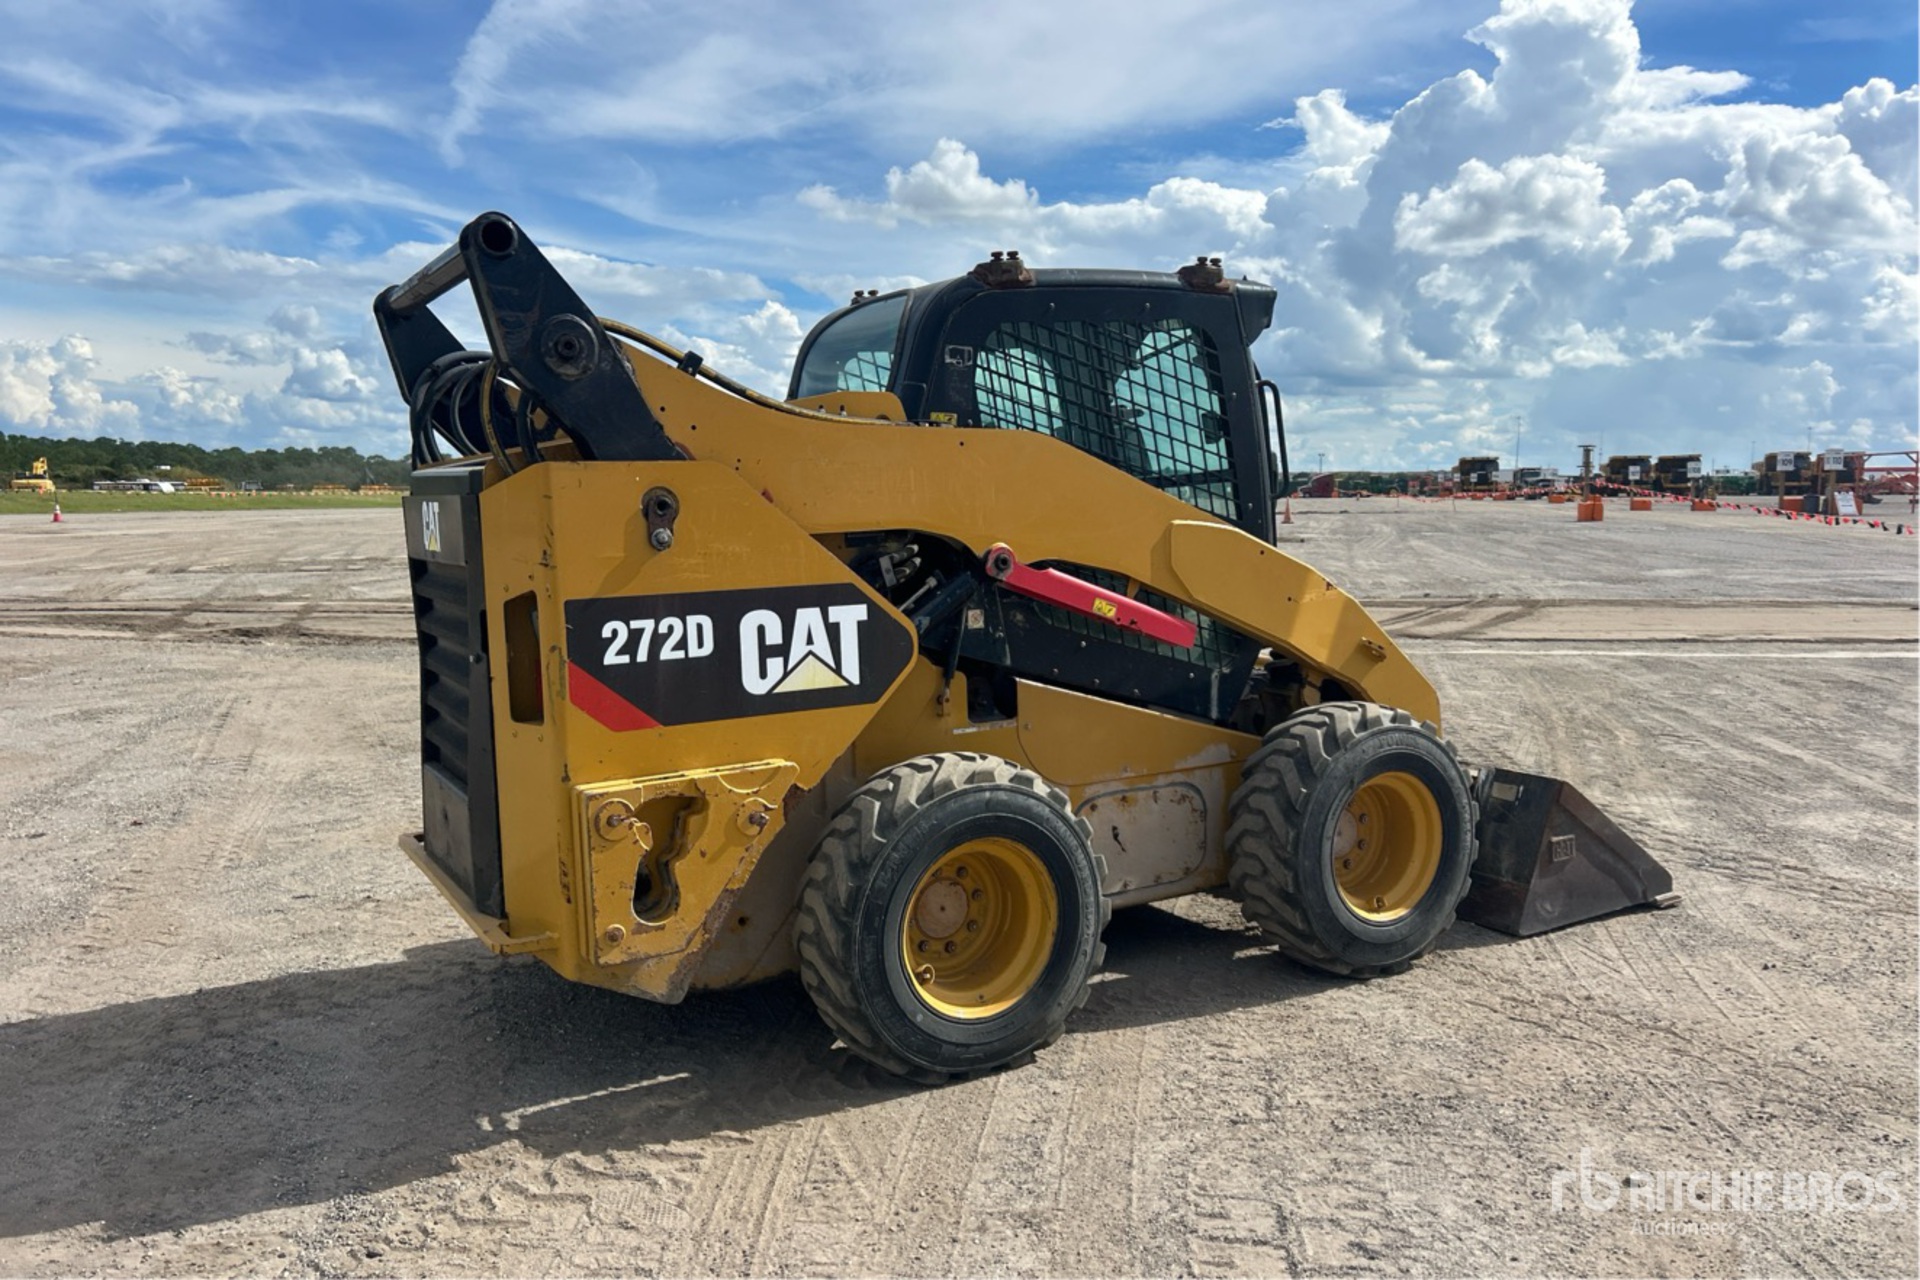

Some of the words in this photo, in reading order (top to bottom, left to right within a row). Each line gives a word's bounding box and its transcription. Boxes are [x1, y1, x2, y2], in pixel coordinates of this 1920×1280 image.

[422, 501, 441, 552] CAT
[601, 614, 714, 665] 272D
[739, 603, 868, 695] CAT
